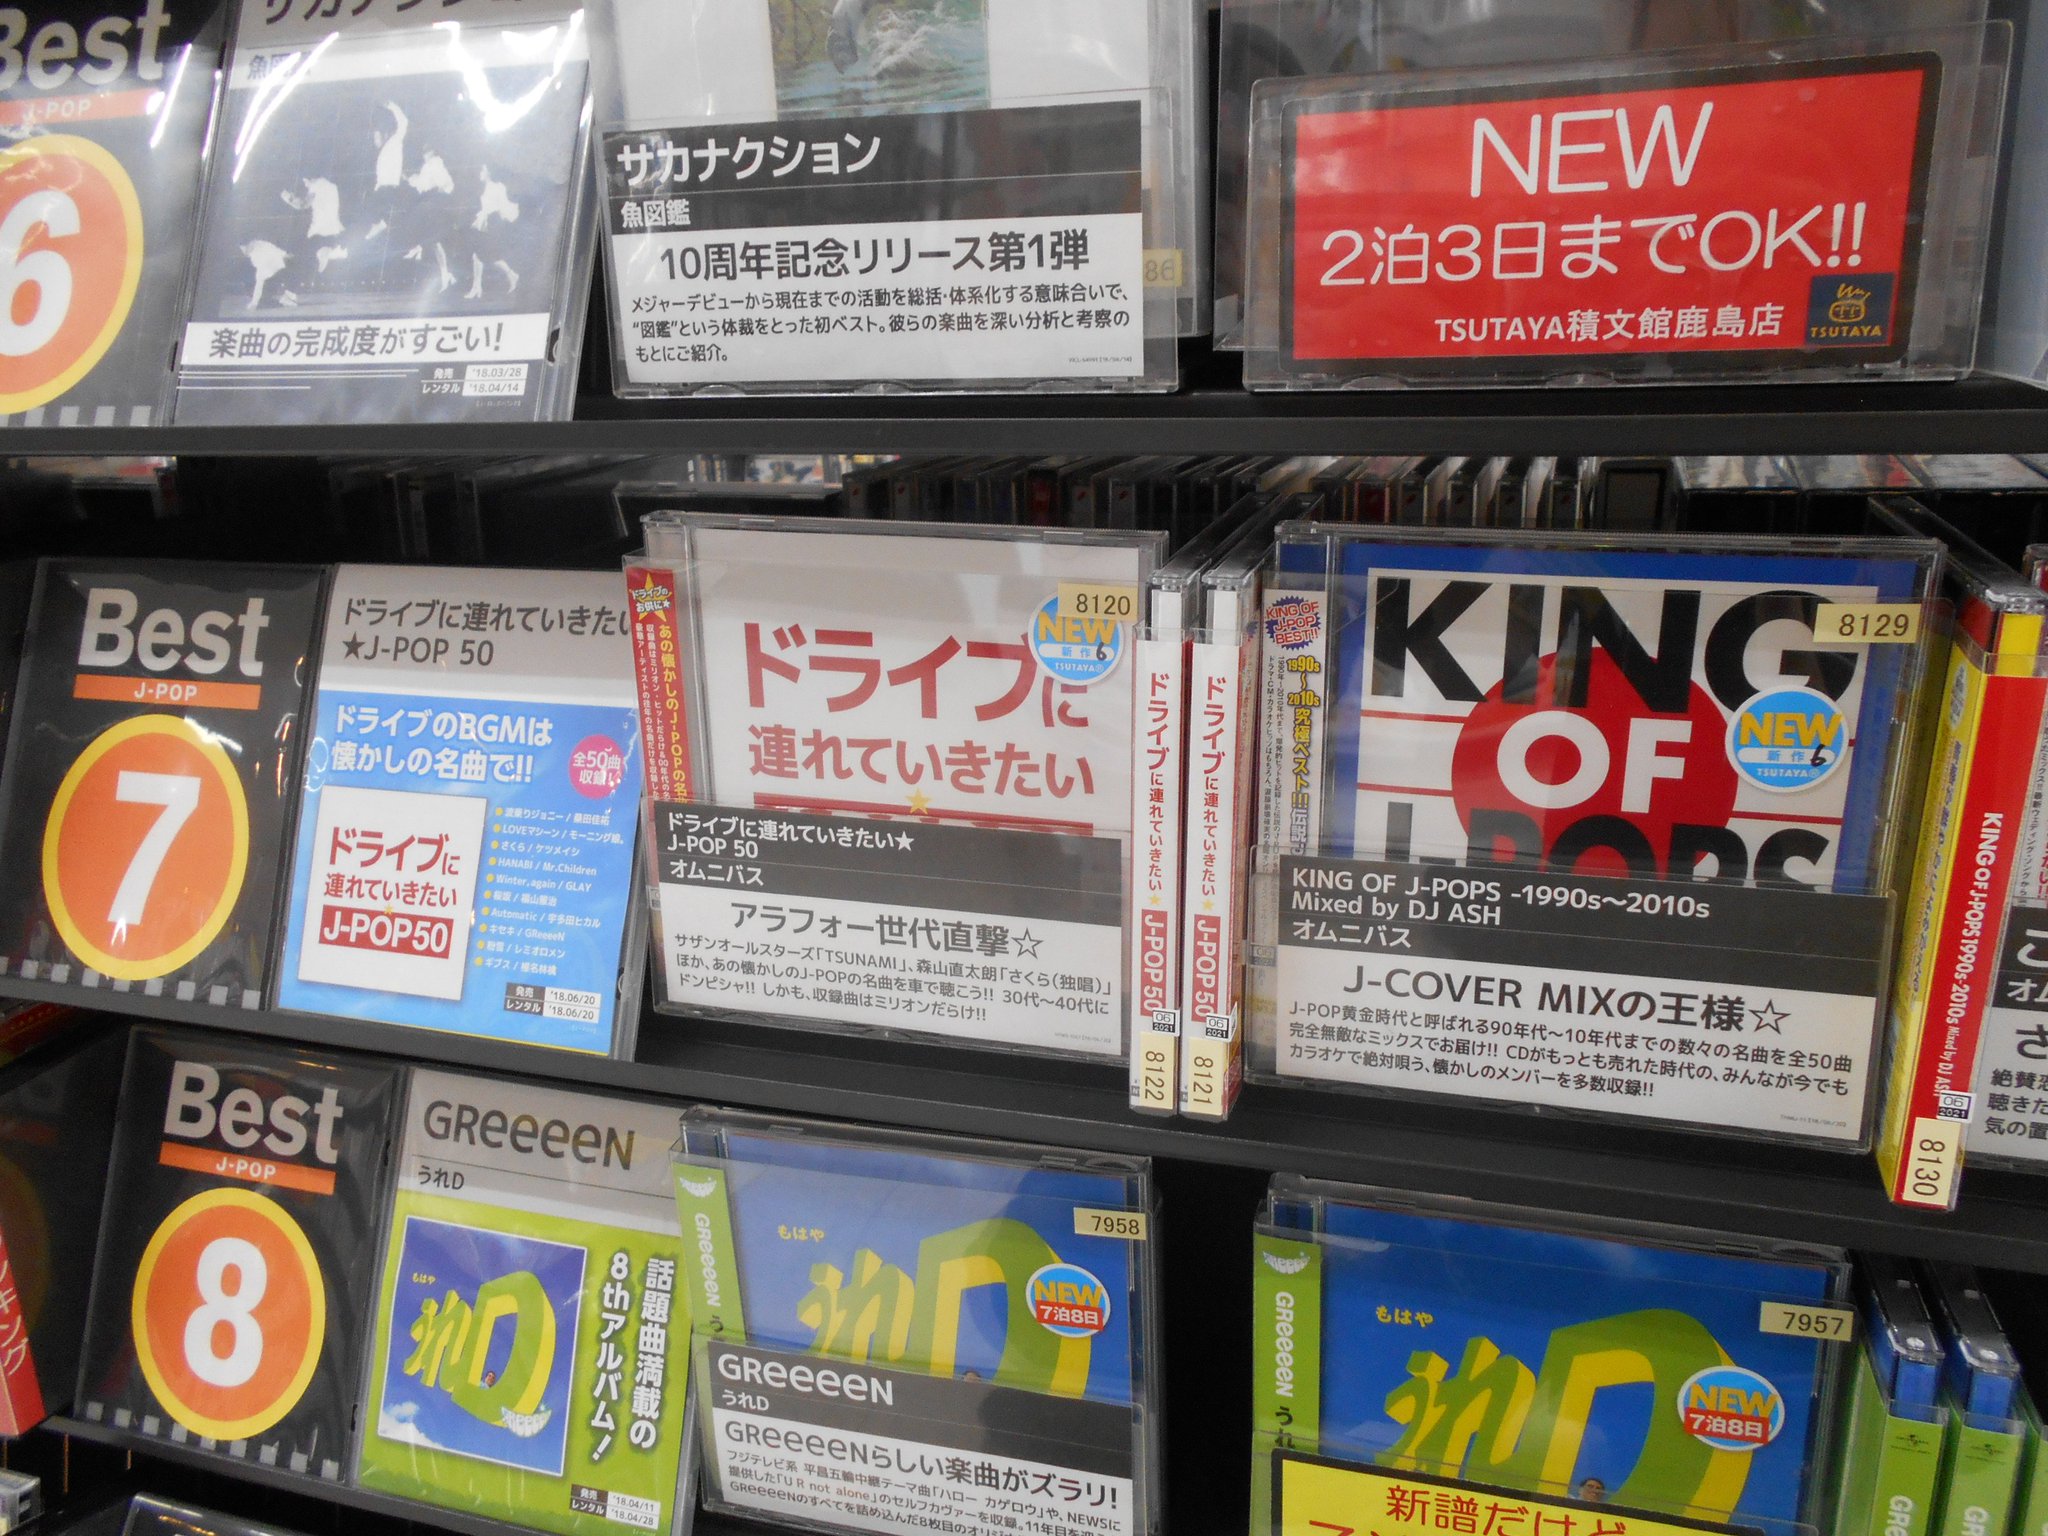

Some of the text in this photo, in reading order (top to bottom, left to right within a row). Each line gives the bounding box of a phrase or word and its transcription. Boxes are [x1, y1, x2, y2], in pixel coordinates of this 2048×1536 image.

[617, 132, 881, 186] サカナクション
[1470, 100, 1714, 200] NEW
[621, 198, 690, 228] 魚図鑑
[659, 227, 1090, 283] 10周年記念リリース第1弾
[1320, 202, 1867, 287] 2泊3日までOK!!
[0, 190, 82, 358] 6
[1434, 302, 1786, 345] TSUTAYA積文館鹿島店
[1810, 323, 1882, 340] TSUTAYA
[209, 322, 504, 359] 楽曲の完成度がすごい!
[635, 342, 727, 363] もとにご紹介。
[433, 366, 523, 380] 発売 '18.03/28
[421, 382, 519, 395] レンタル '18.04/14
[631, 584, 668, 599] ドライブの
[1076, 593, 1131, 616] 8120
[1265, 601, 1319, 619] KING OF
[77, 587, 270, 678] Best
[1038, 611, 1117, 644] NEW
[1274, 627, 1318, 645] BEST!!
[1838, 613, 1910, 637] 8129
[459, 639, 495, 666] 50
[1096, 641, 1108, 661] 6
[1371, 576, 1860, 714] KING
[134, 681, 198, 702] J-POP
[335, 703, 553, 745] ドライブのBGMは
[1739, 712, 1843, 747] NEW
[331, 739, 534, 783] 懐かしの名曲で!!
[572, 750, 621, 771] 全50曲
[747, 723, 1094, 801] 連れていきたい
[1497, 709, 1694, 814] OF
[1810, 744, 1827, 767] 6
[502, 825, 560, 838] LOVEマシーン
[1143, 672, 1170, 1012] ドライブに連れていきたい J-POP 50
[1975, 812, 2003, 867] KING
[107, 770, 201, 926] 7
[330, 827, 460, 875] ドライブに
[501, 841, 580, 856] さくら ケツメイシ
[667, 834, 758, 859] J-POP 50
[1194, 676, 1227, 1017] ドライブに連れていきたい J-POP 50
[498, 857, 597, 876] HANABI Mr.Children
[669, 859, 764, 886] オムニバス
[1973, 868, 1990, 888] OF
[324, 873, 457, 907] 連れていきたい
[566, 880, 592, 893] GLAY
[1292, 867, 1352, 891] KING
[1362, 872, 1397, 894] OF
[1405, 876, 1501, 902] J-POPS
[490, 908, 537, 921] Automatic
[1292, 890, 1500, 925] Mixed by DJ ASH
[489, 924, 566, 942] キセキ GReeeeN
[1292, 919, 1412, 949] オムニバス
[485, 957, 510, 970] ギブス
[514, 943, 566, 958] レミオロメン
[515, 985, 596, 1005] 発売 '18.06/20
[679, 973, 755, 994] ドンピシャ!!
[1343, 964, 1522, 1009] J-COVER
[506, 999, 595, 1021] レンタル '18.06/20
[1155, 1012, 1171, 1023] 06
[1208, 1018, 1224, 1029] 06
[1153, 1023, 1175, 1033] 2021
[1206, 1028, 1227, 1038] 2021
[1289, 1022, 1498, 1058] 完全無敵なミックスでお届け!!
[1145, 1050, 1165, 1101] 8122
[1192, 1056, 1213, 1105] 8121
[163, 1061, 343, 1164] Best
[1938, 1108, 1967, 1118] 2021
[1943, 1096, 1964, 1108] 06
[423, 1100, 635, 1171] GReeeeN
[215, 1157, 278, 1181] J-POP
[417, 1164, 465, 1191] うれD
[1912, 1138, 1945, 1197] 8130
[778, 1224, 825, 1242] もはや
[1090, 1214, 1141, 1237] 7958
[695, 1212, 721, 1307] GReeeeN
[411, 1271, 437, 1286] もはや
[1034, 1279, 1103, 1308] NEW
[184, 1237, 267, 1387] 8
[1039, 1304, 1099, 1326] 7泊8日
[1376, 1304, 1434, 1328] もはや
[1783, 1311, 1844, 1335] 7957
[591, 1251, 631, 1462] 8thアルバム!
[629, 1258, 675, 1449] 話題曲満載の
[1275, 1291, 1294, 1398] GReeeeN
[717, 1352, 894, 1406] GReeeeN
[722, 1388, 770, 1412] うれD
[1689, 1382, 1778, 1418] NEW
[1689, 1413, 1763, 1438] 7泊8日
[726, 1420, 1117, 1510] GReeeeNらしい楽曲がズラリ!
[580, 1487, 655, 1512] 発売 '18.04/11
[727, 1450, 798, 1473] フジテレビ系
[985, 1496, 1121, 1531] カゲロウ」や、NEWSに
[809, 1482, 831, 1494] not
[571, 1499, 655, 1527] レンタル '18.04/28
